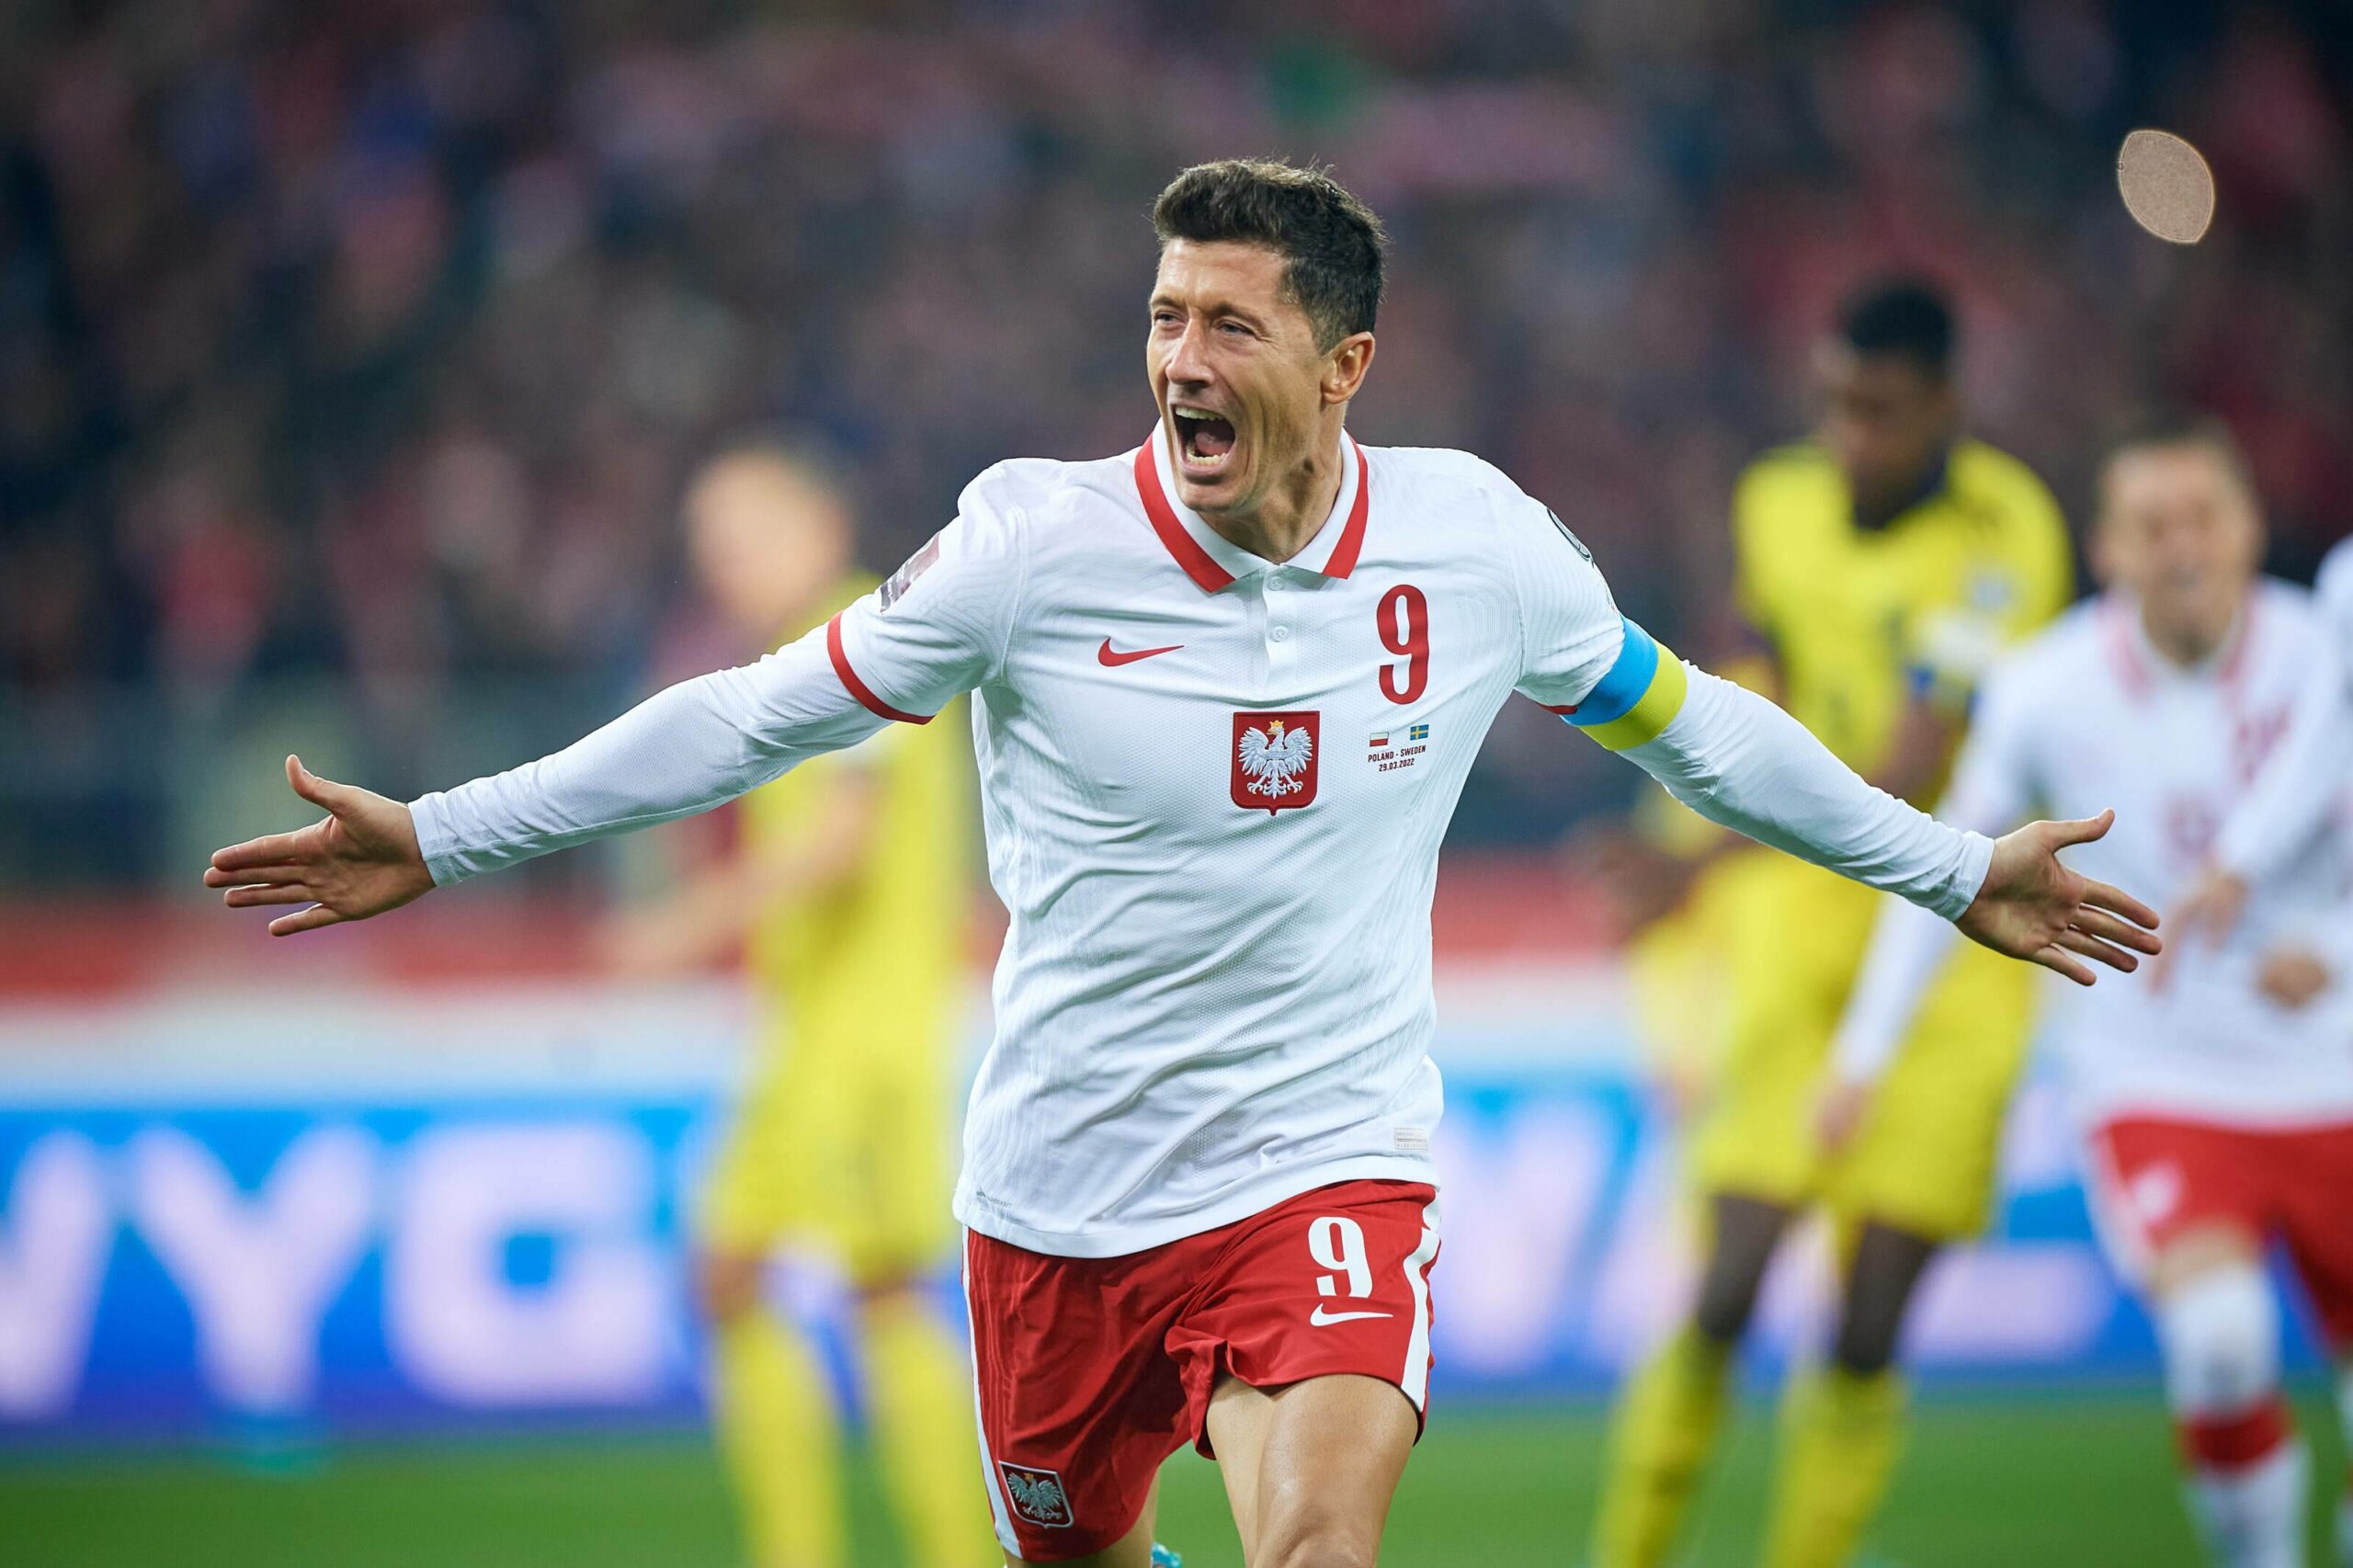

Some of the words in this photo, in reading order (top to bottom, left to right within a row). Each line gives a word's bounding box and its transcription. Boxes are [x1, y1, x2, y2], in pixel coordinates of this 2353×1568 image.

[1377, 585, 1429, 704] 9
[1368, 751, 1393, 762] POLAND
[1400, 744, 1426, 757] SWEDEN
[1379, 758, 1415, 772] 29.03.2022
[1308, 1216, 1372, 1298] 9
